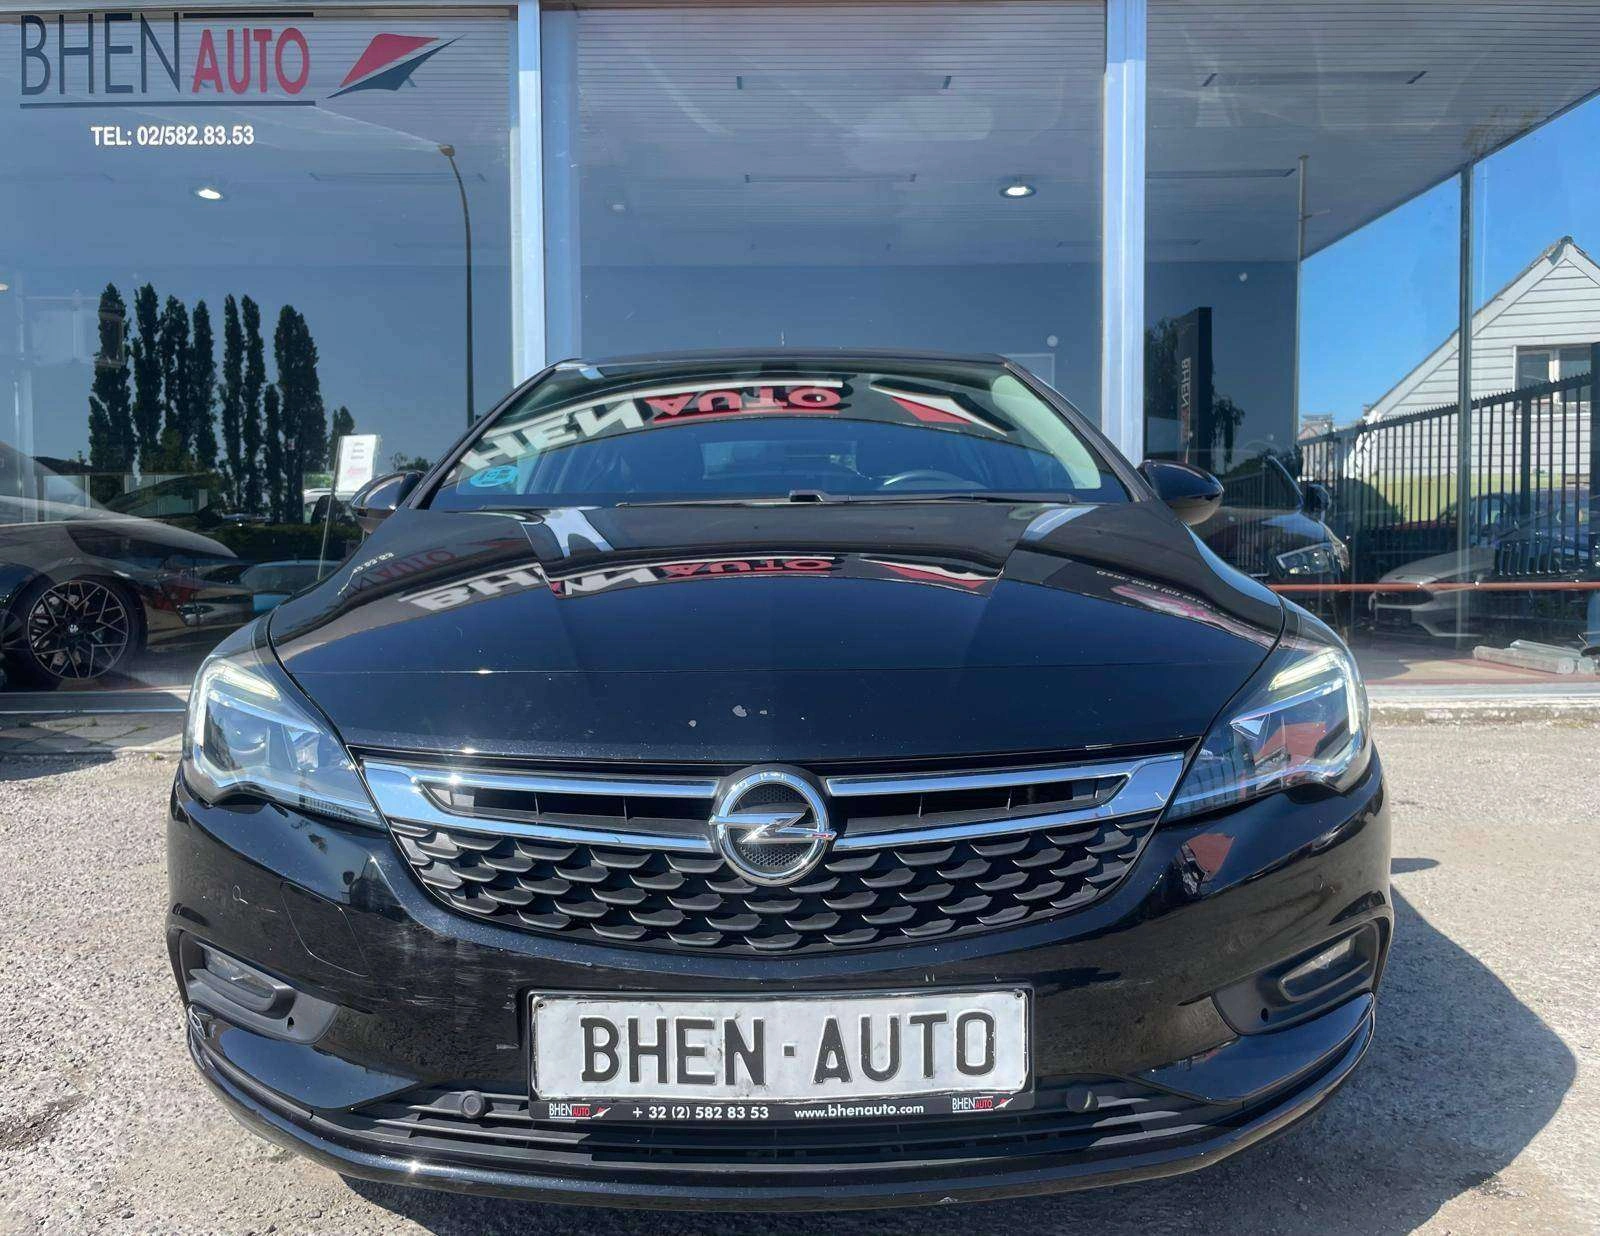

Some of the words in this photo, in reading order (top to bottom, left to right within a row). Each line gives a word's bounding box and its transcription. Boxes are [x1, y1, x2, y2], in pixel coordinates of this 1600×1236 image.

[90, 126, 132, 146] TEL:
[136, 125, 255, 146] 02/582.83.53
[580, 1016, 767, 1086] BHEN
[813, 1011, 996, 1085] AUTO
[649, 1107, 667, 1119] 32
[671, 1106, 690, 1119] (2)
[695, 1106, 723, 1119] 582
[727, 1106, 746, 1119] 83
[750, 1106, 770, 1119] 53
[793, 1103, 925, 1118] www.bhenauto.com
